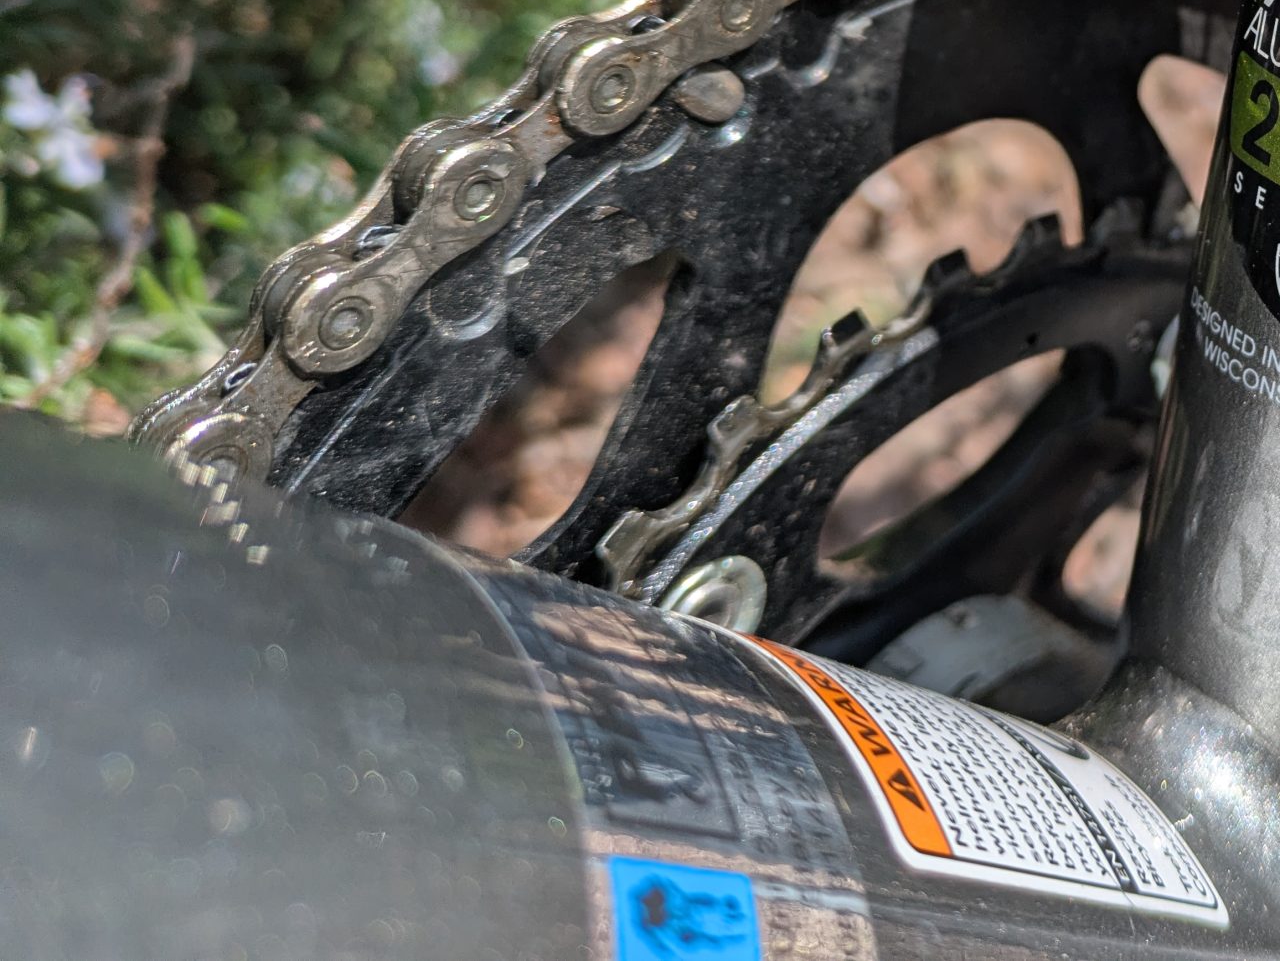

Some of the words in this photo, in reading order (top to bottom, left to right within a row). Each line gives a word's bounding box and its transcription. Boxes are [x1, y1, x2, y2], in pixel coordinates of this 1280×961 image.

[1190, 286, 1257, 359] DESIGNED
[876, 716, 923, 763] ride
[900, 725, 930, 750] or
[934, 734, 998, 803] safely
[987, 747, 1029, 788] you
[916, 767, 969, 847] Never
[940, 757, 1006, 855] without
[981, 772, 1043, 864] serious
[1021, 772, 1067, 826] have
[1022, 791, 1077, 870] before
[987, 807, 1025, 859] ride
[1015, 803, 1059, 866] Read
[1061, 831, 1093, 873] not
[1071, 821, 1111, 877] your
[1096, 807, 1153, 885] Racing
[1099, 798, 1166, 888] Bicycles
[1102, 847, 1131, 881] EN
